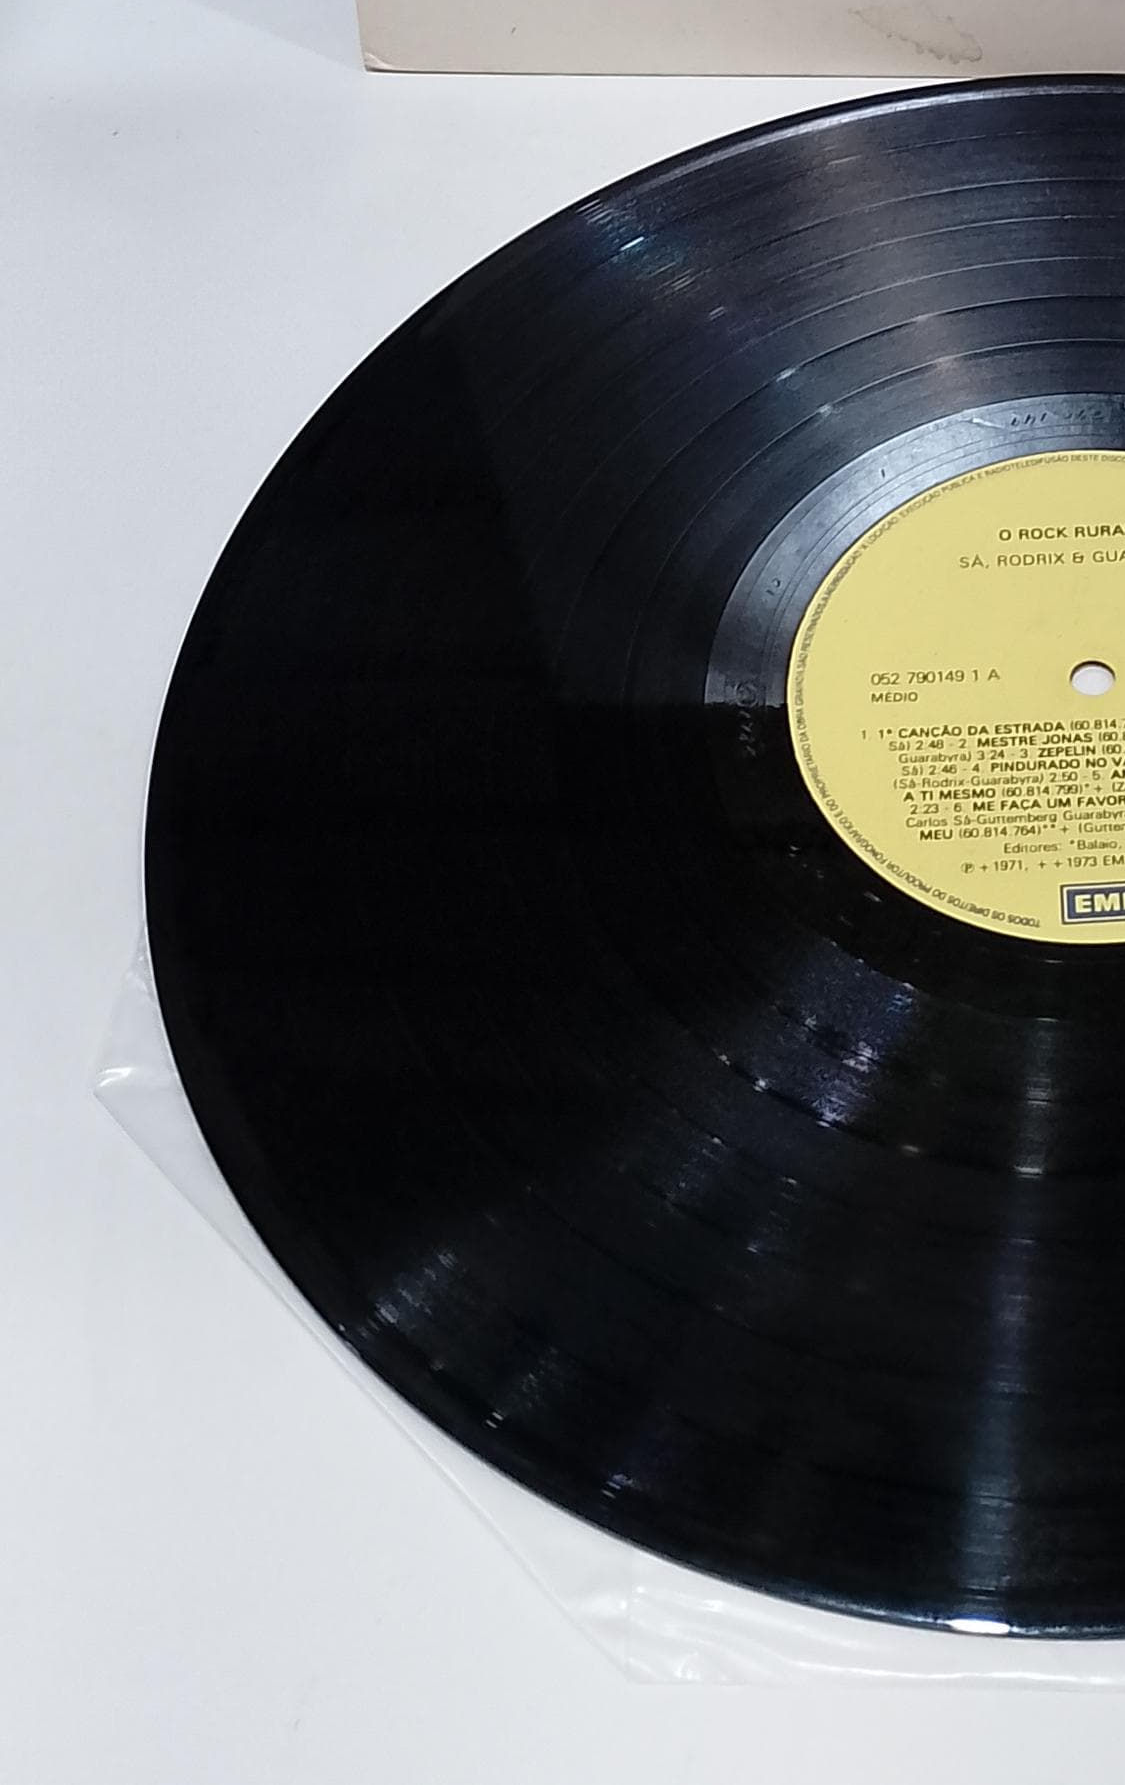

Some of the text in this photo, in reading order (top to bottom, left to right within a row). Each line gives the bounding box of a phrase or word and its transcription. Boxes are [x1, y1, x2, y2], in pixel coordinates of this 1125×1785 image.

[999, 529, 1011, 541] O
[1019, 527, 1068, 540] ROCK
[960, 554, 989, 569] SÁ,
[997, 553, 1064, 567] RODRIX
[1073, 552, 1084, 563] &
[871, 669, 1000, 685] 052 790149 1 A
[899, 726, 963, 741] CANÇÃO
[968, 726, 989, 736] DA
[995, 722, 1065, 734] ESTRADA
[977, 735, 1037, 747] MESTRE
[1042, 733, 1093, 745] JONAS
[899, 751, 971, 763] Guarabyra)
[1038, 746, 1096, 758] ZEPELIN
[991, 759, 1080, 772] PINDURADO
[1086, 758, 1107, 768] NO
[904, 792, 914, 802] A
[919, 791, 933, 801] TI
[939, 788, 996, 800] MESMO
[825, 798, 839, 811] DO
[973, 801, 994, 811] ME
[1001, 799, 1041, 811] FAÇA
[1047, 798, 1071, 808] UM
[906, 817, 948, 828] Carlos
[920, 829, 953, 840] MEU
[1067, 856, 1097, 867] 1973
[884, 861, 932, 893] PRODUTOR
[930, 889, 947, 900] DO
[945, 896, 990, 917] DIREITOS
[990, 911, 1006, 921] OS
[1006, 915, 1040, 927] TODOS
